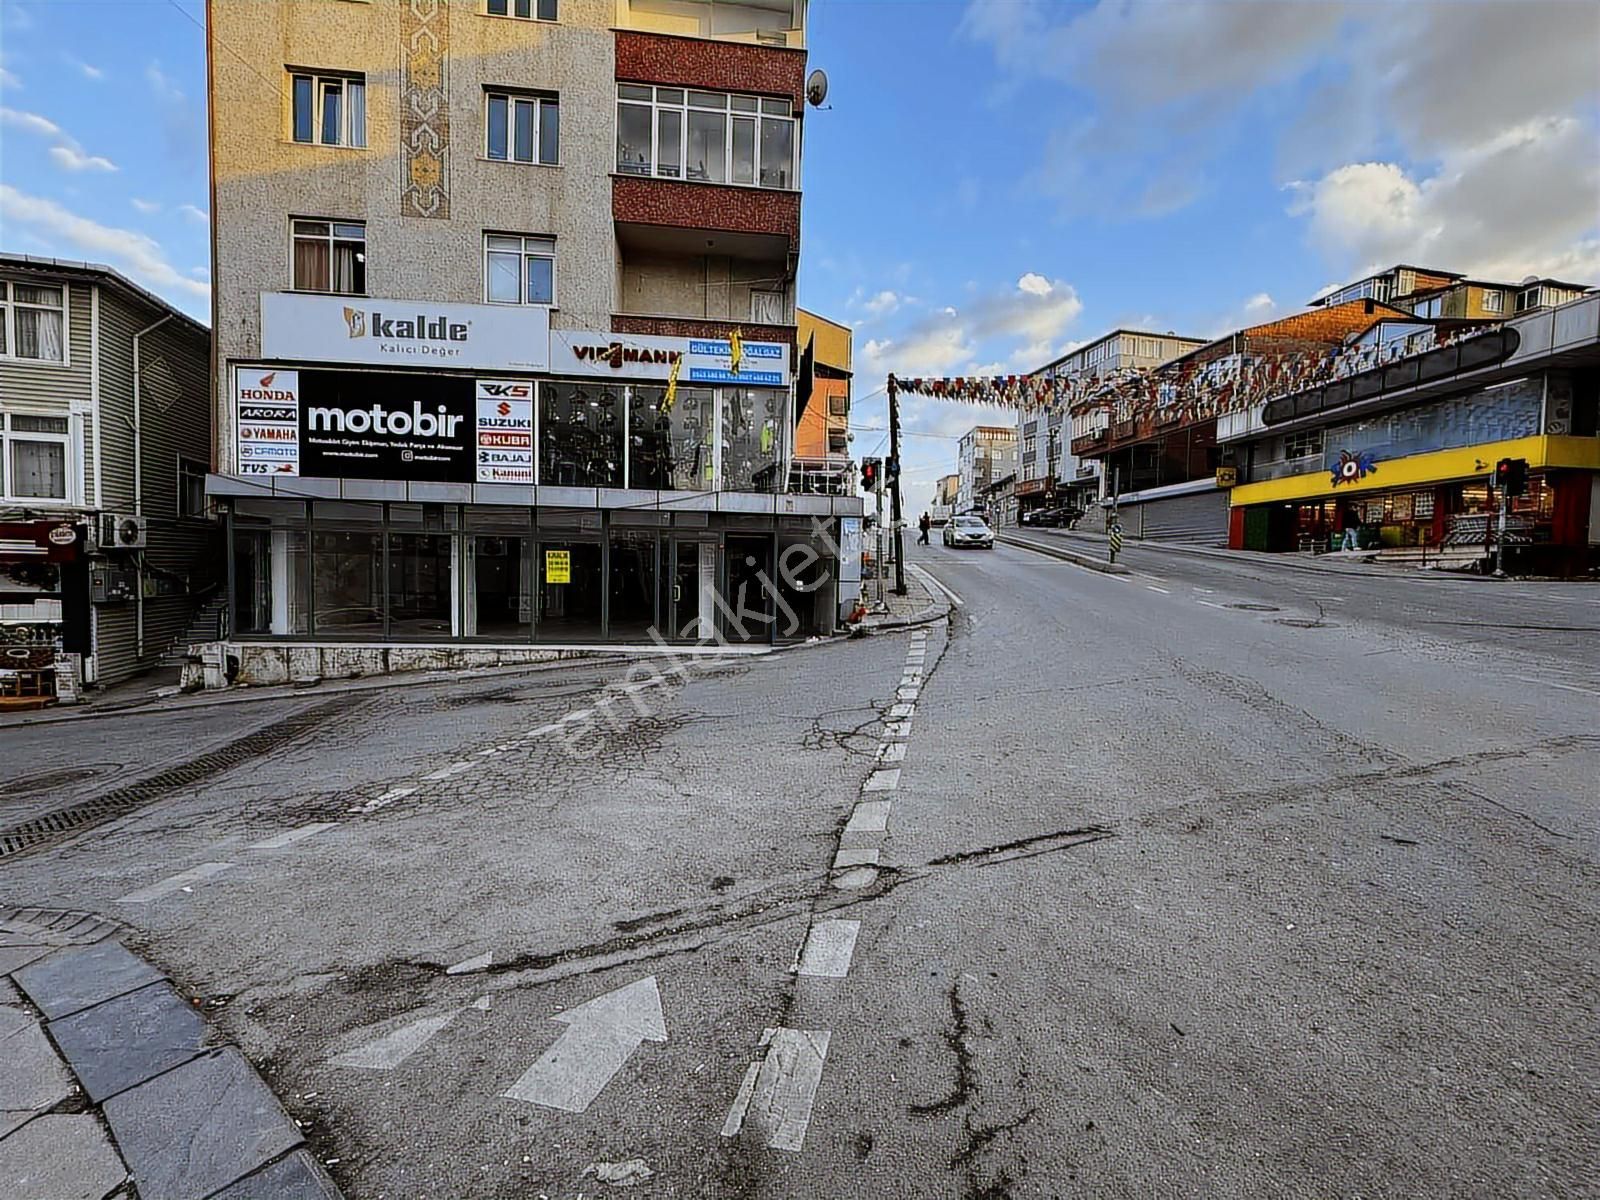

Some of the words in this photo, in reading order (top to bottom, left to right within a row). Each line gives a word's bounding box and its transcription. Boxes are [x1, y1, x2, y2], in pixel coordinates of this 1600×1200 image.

[372, 313, 467, 341] kalde
[422, 345, 460, 357] Değer
[241, 389, 296, 401] HONDA
[308, 401, 463, 437] motobir
[479, 418, 531, 428] SUZUKI
[253, 428, 297, 440] YAMAHA
[493, 435, 529, 446] KUBA
[491, 453, 531, 463] BAJAJ
[241, 464, 268, 473] TVS
